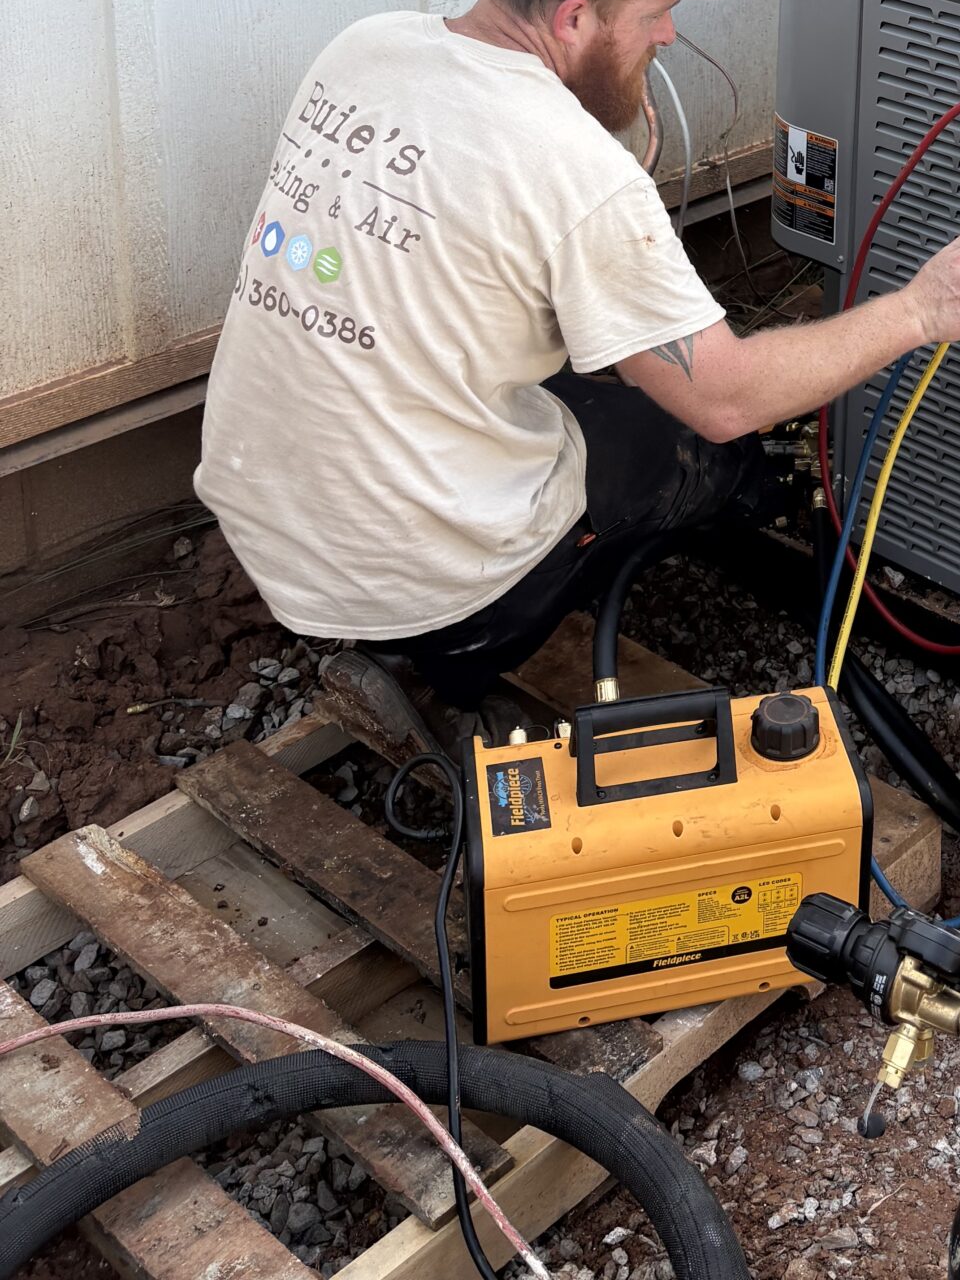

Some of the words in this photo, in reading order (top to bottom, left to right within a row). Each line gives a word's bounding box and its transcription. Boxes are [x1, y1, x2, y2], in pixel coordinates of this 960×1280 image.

[299, 81, 426, 175] Buie's
[328, 196, 341, 219] &
[354, 206, 421, 253] Air
[249, 278, 375, 349] 360-0386
[508, 768, 526, 825] Fieldpiece
[555, 914, 581, 923] TYPICAL
[583, 908, 619, 918] OPERATION
[734, 893, 750, 901] A2L
[652, 952, 702, 968] Fieldpiece
